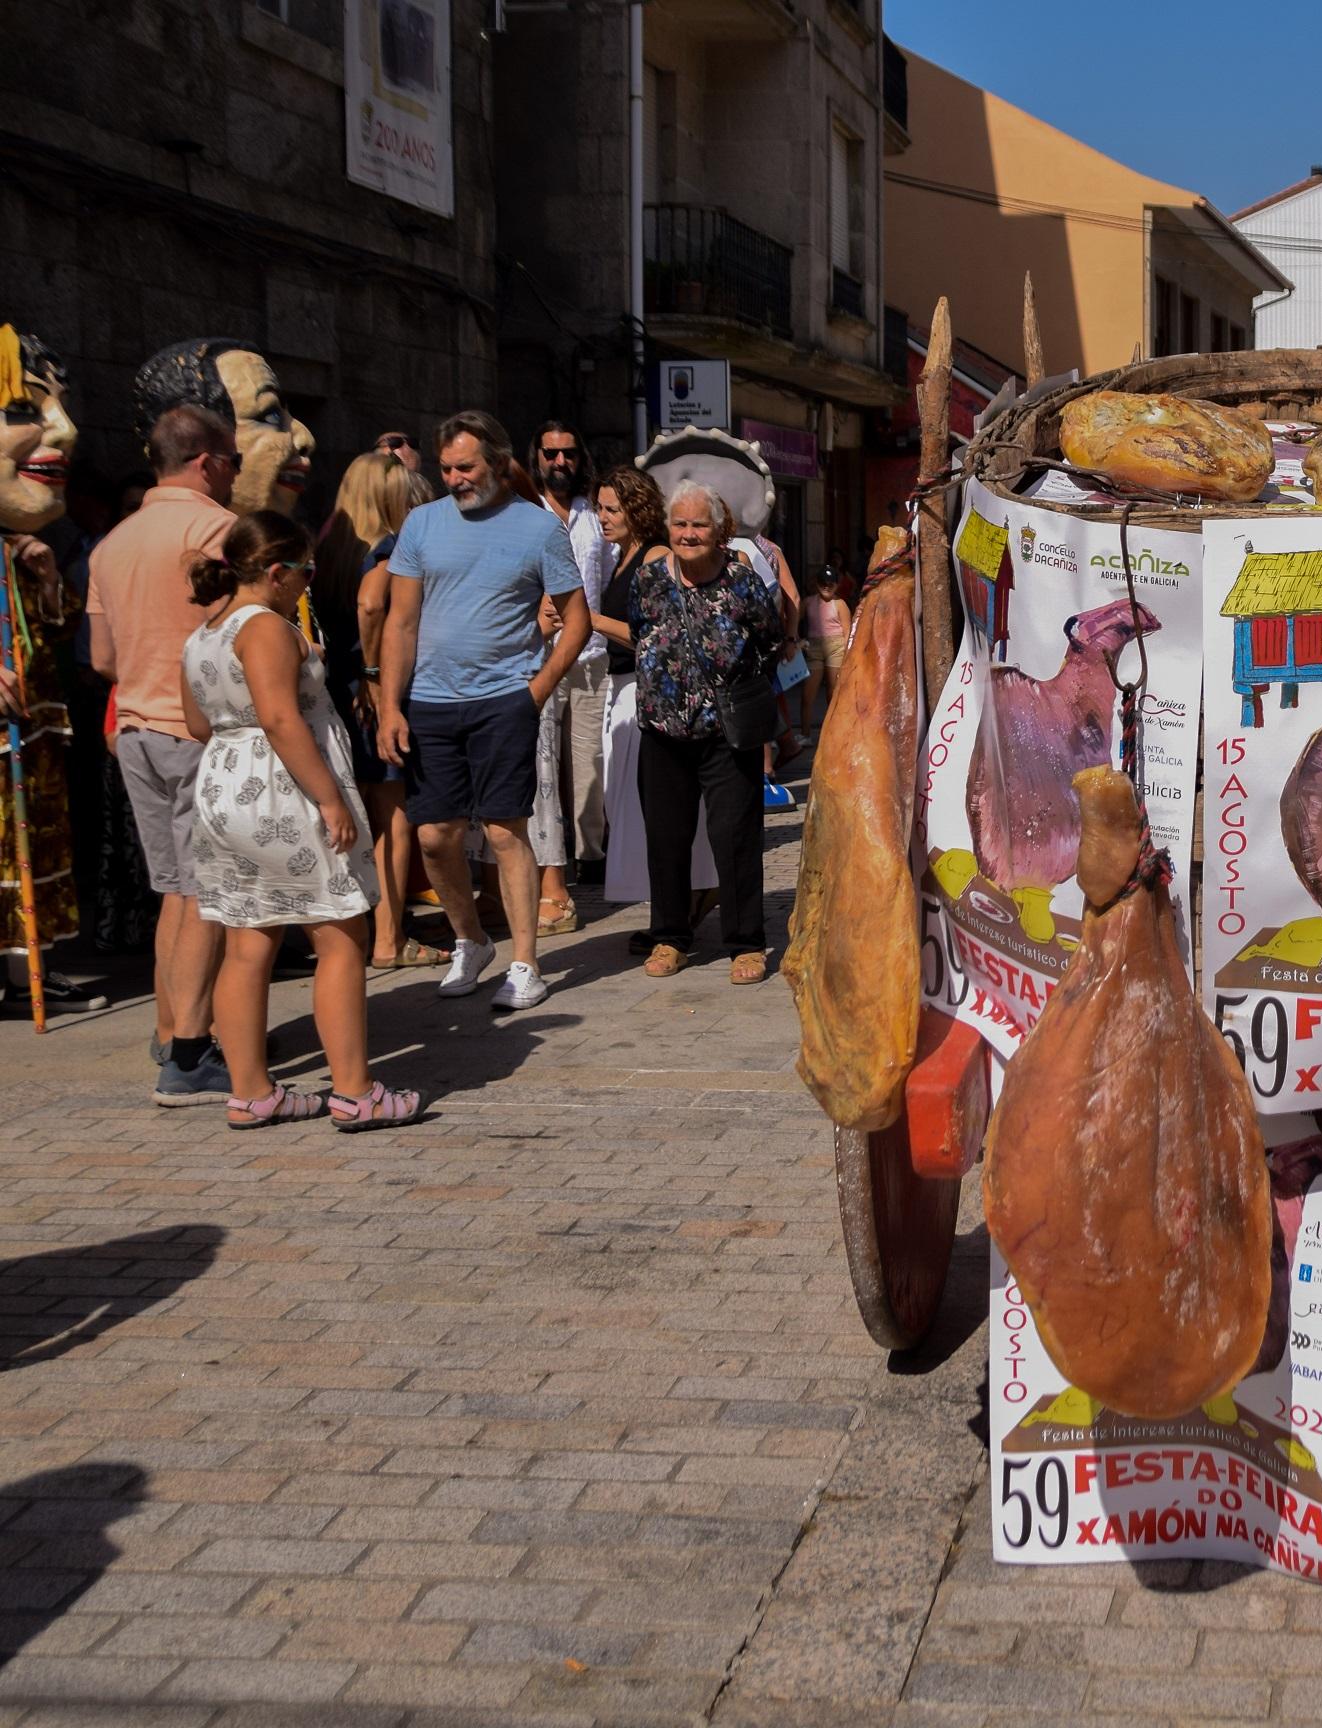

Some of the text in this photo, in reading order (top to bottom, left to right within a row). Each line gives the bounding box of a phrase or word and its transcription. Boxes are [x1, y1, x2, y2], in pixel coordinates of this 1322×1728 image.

[1038, 542, 1076, 559] CONCELLO
[1140, 575, 1148, 584] EN
[960, 660, 973, 685] 15
[1148, 754, 1183, 766] GALICIA
[1216, 738, 1246, 766] 15
[1217, 773, 1249, 935] AGOSTO
[1261, 966, 1309, 982] Festa
[1003, 1270, 1028, 1404] GOSTO
[1002, 1457, 1069, 1549] 59
[1197, 1488, 1242, 1511] DO
[1075, 1500, 1207, 1545] XAMÓN
[1216, 1514, 1250, 1542] NA
